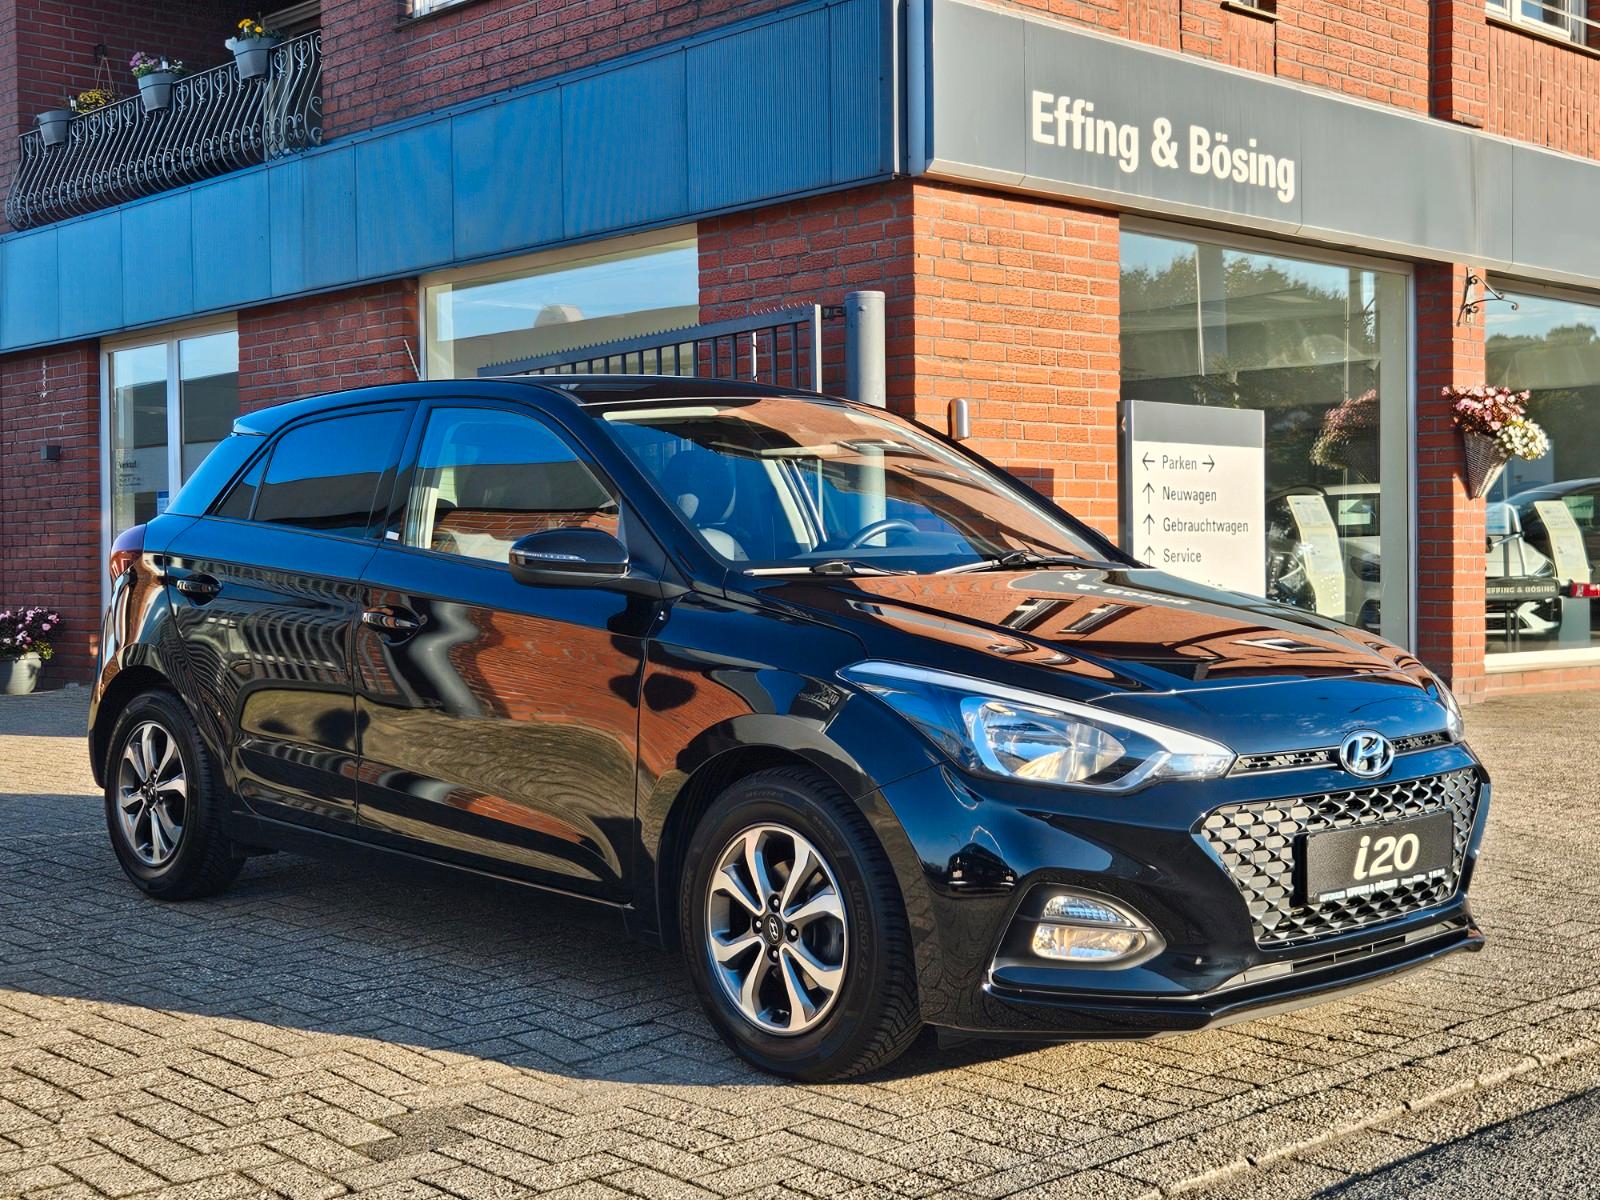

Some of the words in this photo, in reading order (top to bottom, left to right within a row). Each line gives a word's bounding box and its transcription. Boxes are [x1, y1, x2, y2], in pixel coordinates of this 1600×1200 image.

[1032, 90, 1139, 173] Effing
[1151, 117, 1179, 169] &
[1189, 125, 1296, 203] Bösing
[1163, 455, 1196, 469] Parken
[1163, 486, 1216, 504] Neuwagen
[1163, 517, 1248, 535] Gebrauchtwagen
[1164, 548, 1201, 562] Service
[1353, 833, 1420, 881] i20
